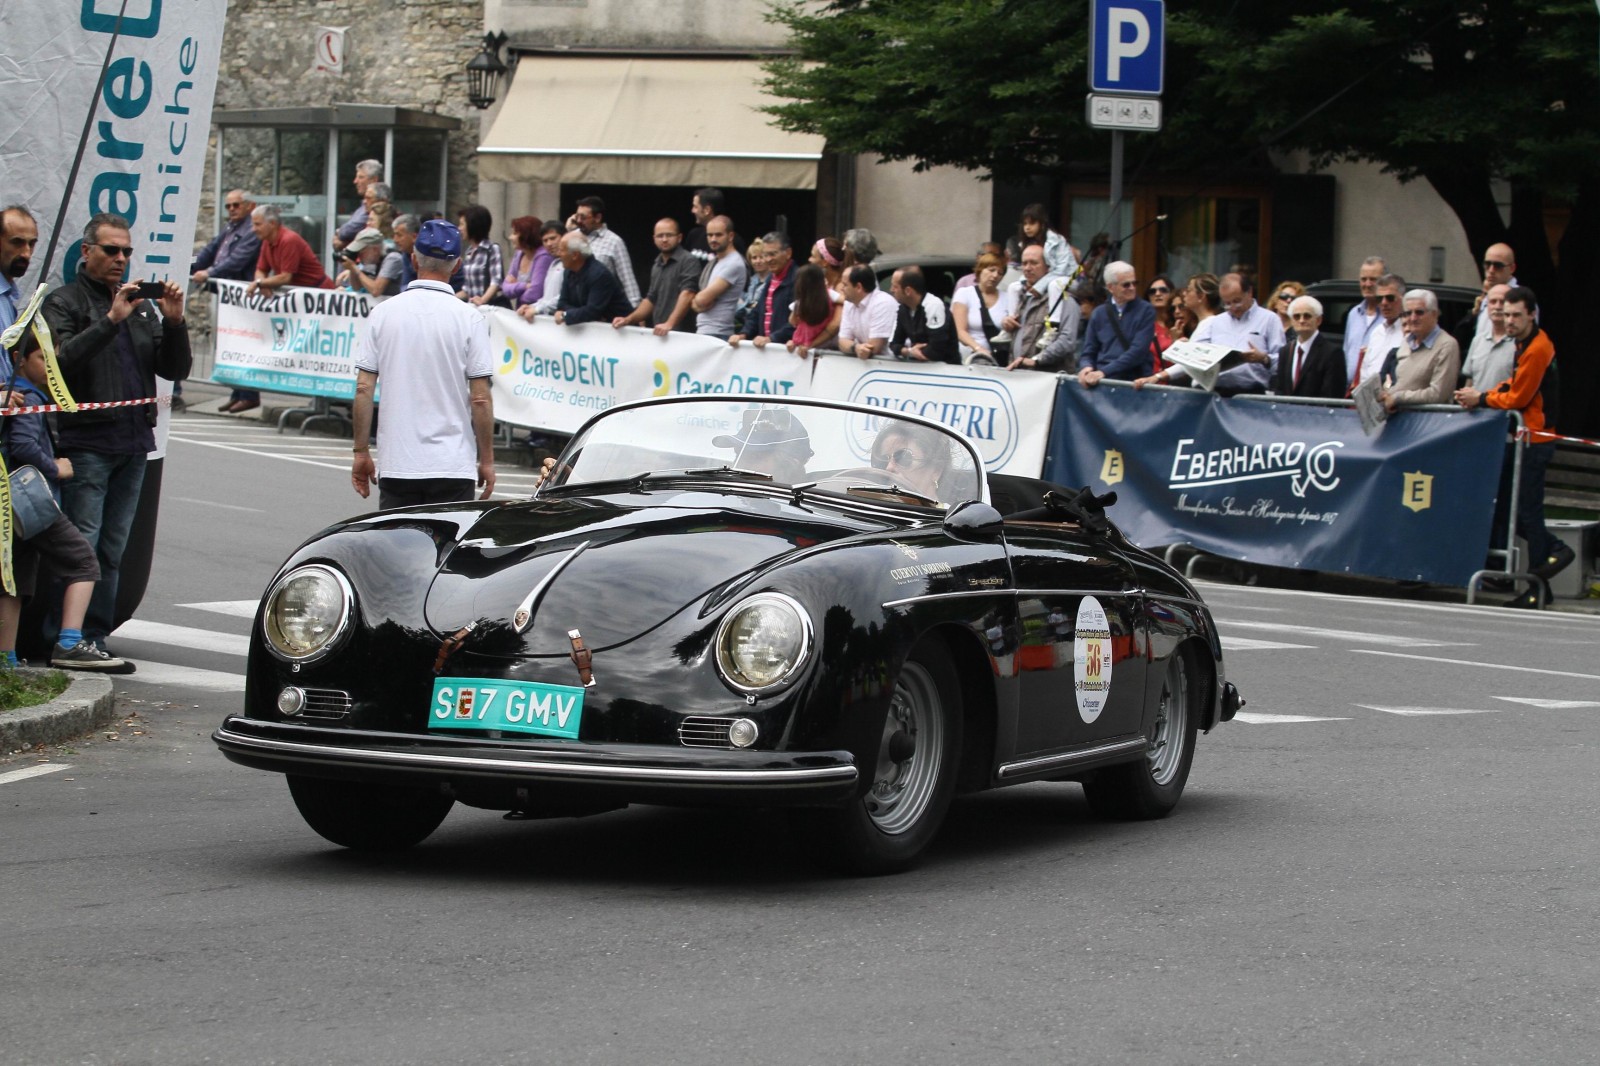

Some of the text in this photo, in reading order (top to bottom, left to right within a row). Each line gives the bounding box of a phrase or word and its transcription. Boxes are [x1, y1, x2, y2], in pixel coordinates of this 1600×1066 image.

[1107, 7, 1150, 81] P
[303, 292, 369, 318] DANILO
[288, 317, 356, 358] Vaillant
[299, 360, 351, 374] AUTORIZZATA
[522, 348, 620, 389] CareDENT
[513, 382, 617, 411] cliniche dentali
[1107, 458, 1119, 477] E
[1170, 438, 1306, 481] EBERHARD
[1411, 480, 1423, 502] E
[890, 566, 919, 581] CUERVO
[1086, 643, 1101, 677] 56
[435, 686, 576, 728] S 7 GMV
